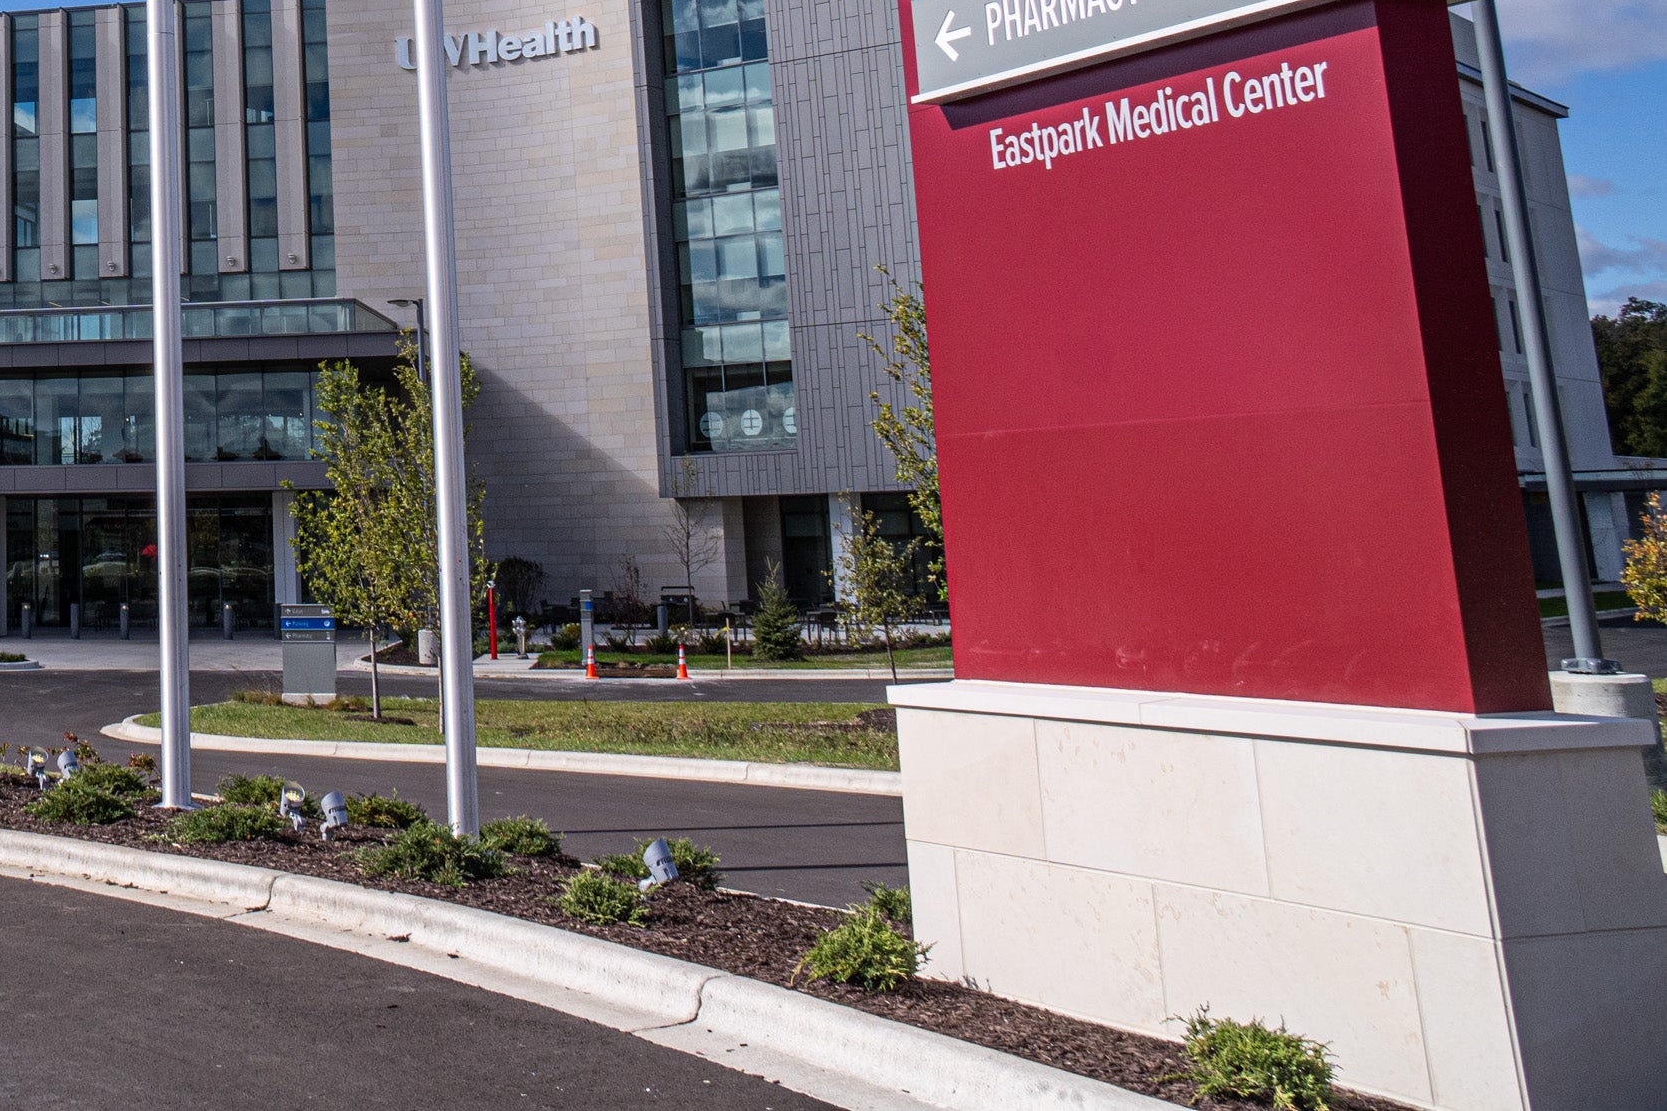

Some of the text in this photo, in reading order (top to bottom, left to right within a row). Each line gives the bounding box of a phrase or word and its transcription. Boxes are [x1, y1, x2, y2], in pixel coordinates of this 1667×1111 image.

[989, 61, 1327, 169] Eastpark Medical Center
